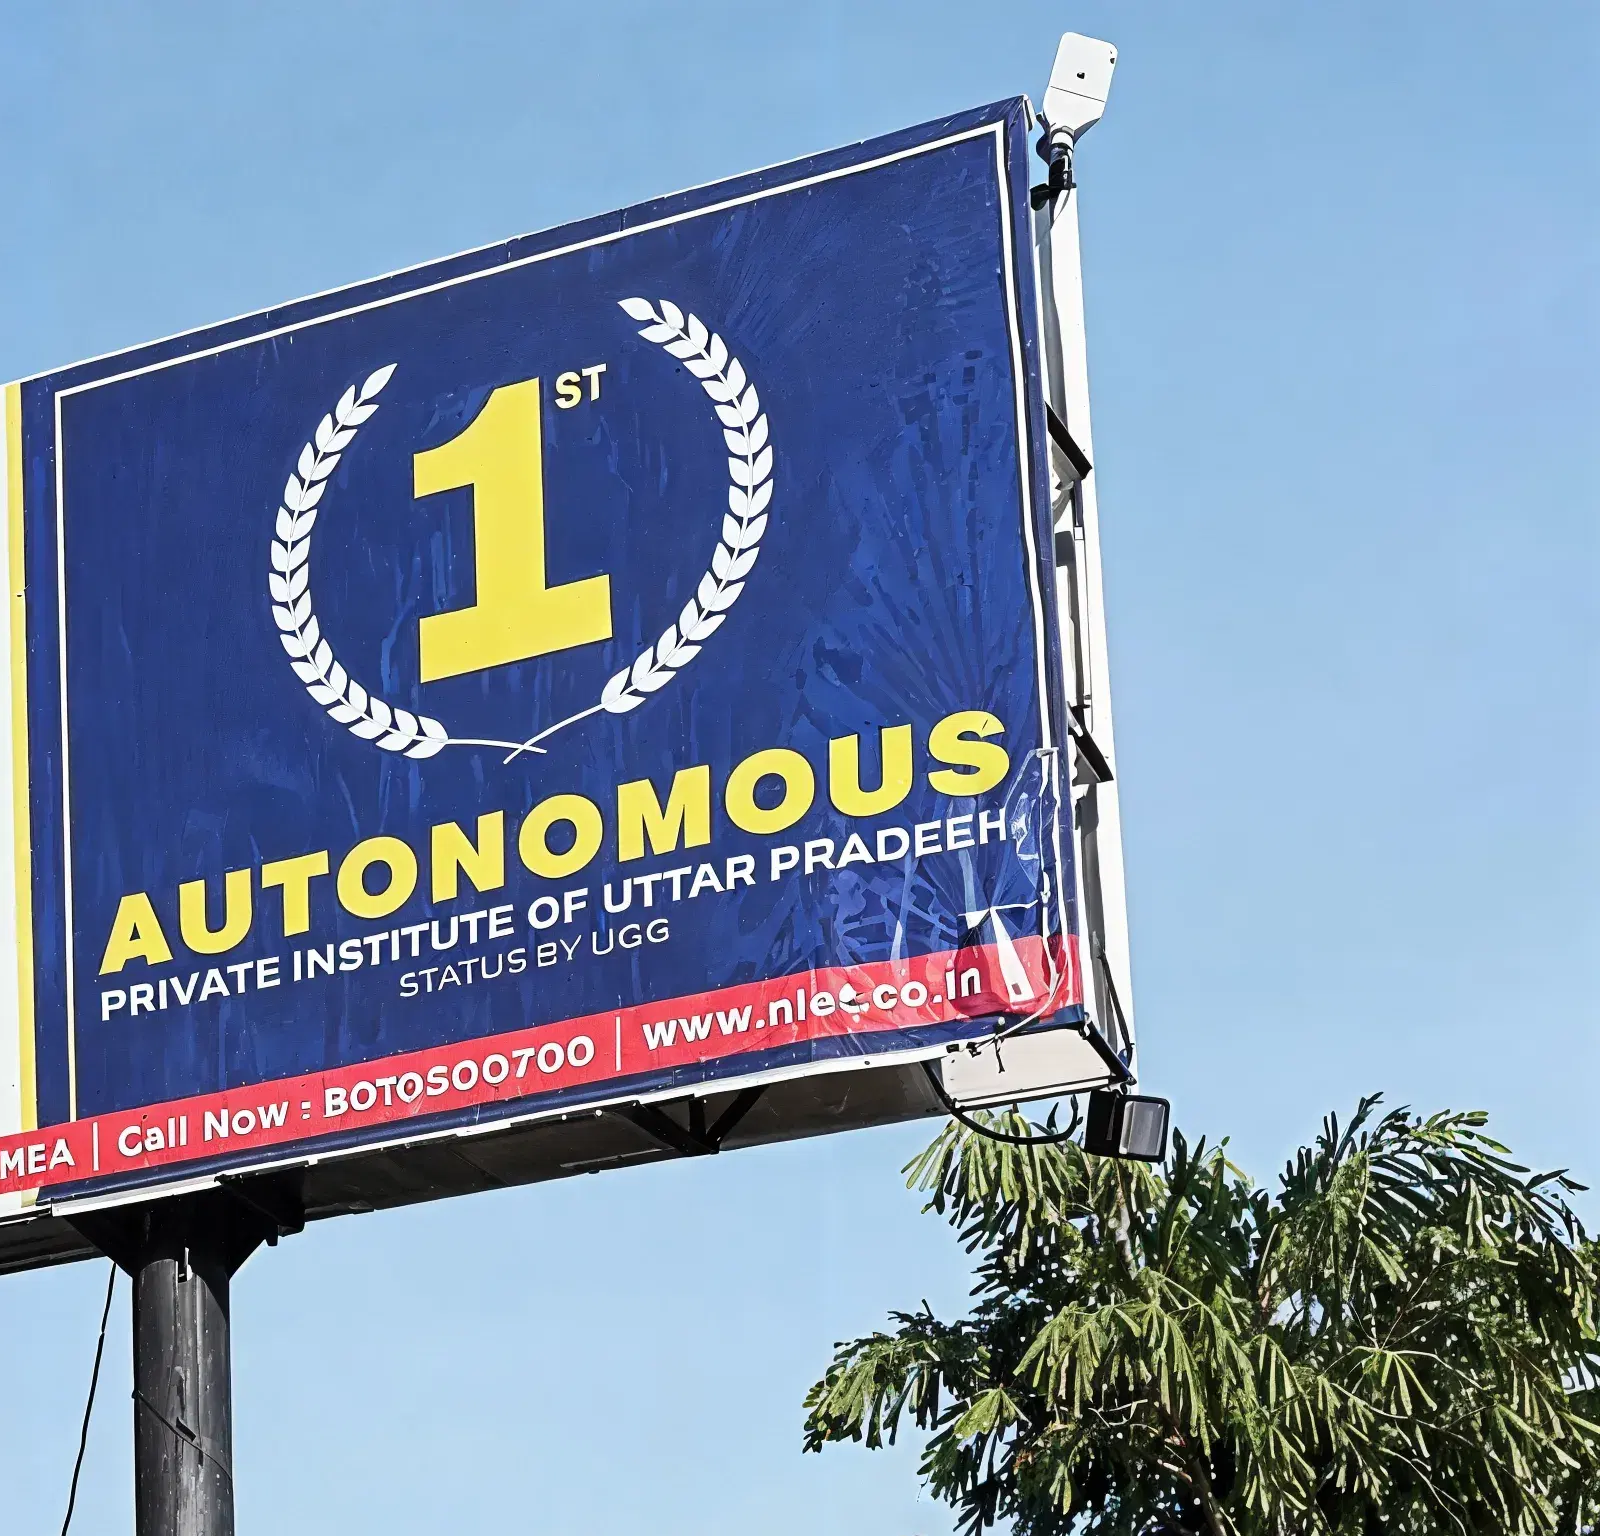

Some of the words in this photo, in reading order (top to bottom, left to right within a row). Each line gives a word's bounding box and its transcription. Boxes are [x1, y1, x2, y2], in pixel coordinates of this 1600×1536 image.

[98, 709, 1011, 976] AUTONOMOUS
[101, 956, 282, 1023] PRIVATE
[293, 904, 516, 983] INSTITUTE
[527, 887, 590, 930] OF
[603, 852, 757, 915] UTTAR
[399, 946, 528, 999] STATUS
[536, 934, 584, 968] BY
[117, 1117, 189, 1158] Call
[203, 1101, 289, 1143] Now
